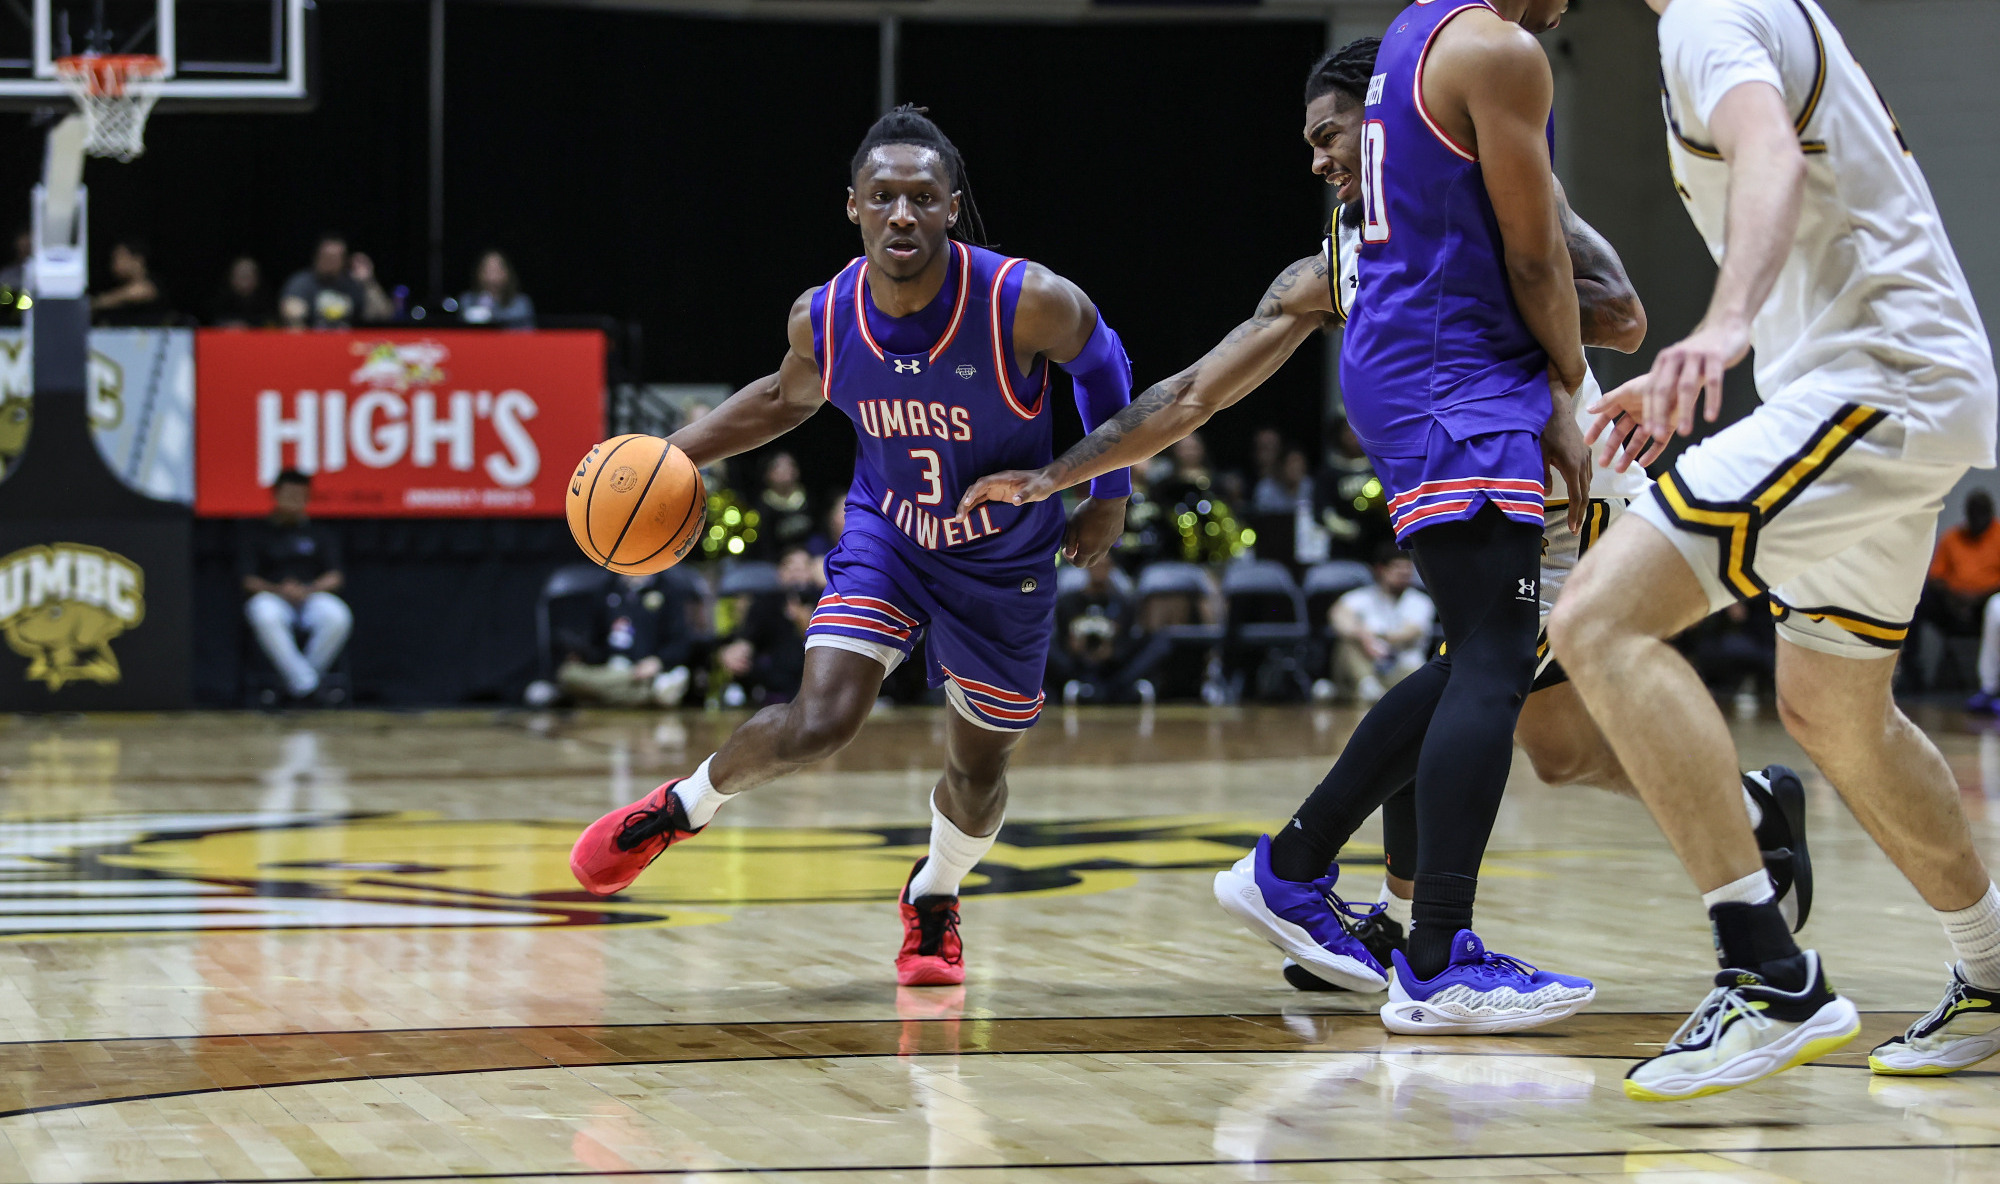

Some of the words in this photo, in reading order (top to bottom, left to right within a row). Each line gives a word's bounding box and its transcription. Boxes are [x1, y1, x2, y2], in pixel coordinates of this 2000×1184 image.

[256, 388, 541, 488] HIGH'S
[857, 398, 972, 441] UMASS
[908, 447, 943, 506] 3
[0, 550, 138, 621] UMBC
